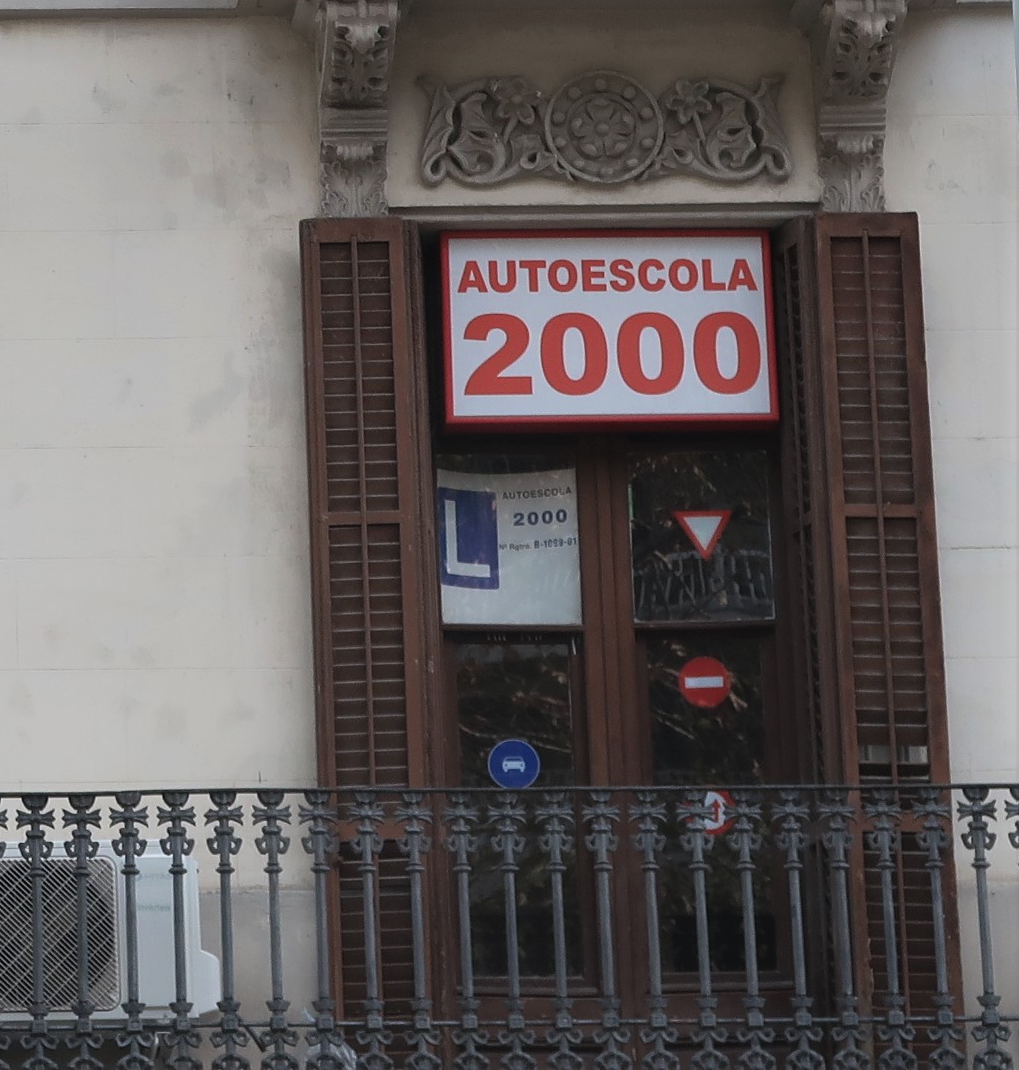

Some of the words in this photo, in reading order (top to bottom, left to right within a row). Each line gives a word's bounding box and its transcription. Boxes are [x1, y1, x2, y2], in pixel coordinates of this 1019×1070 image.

[457, 258, 758, 293] AUTOESCOLA
[463, 311, 761, 396] 2000
[502, 487, 572, 500] AUTOESCOLA
[513, 509, 568, 527] 2000
[444, 499, 491, 578] L
